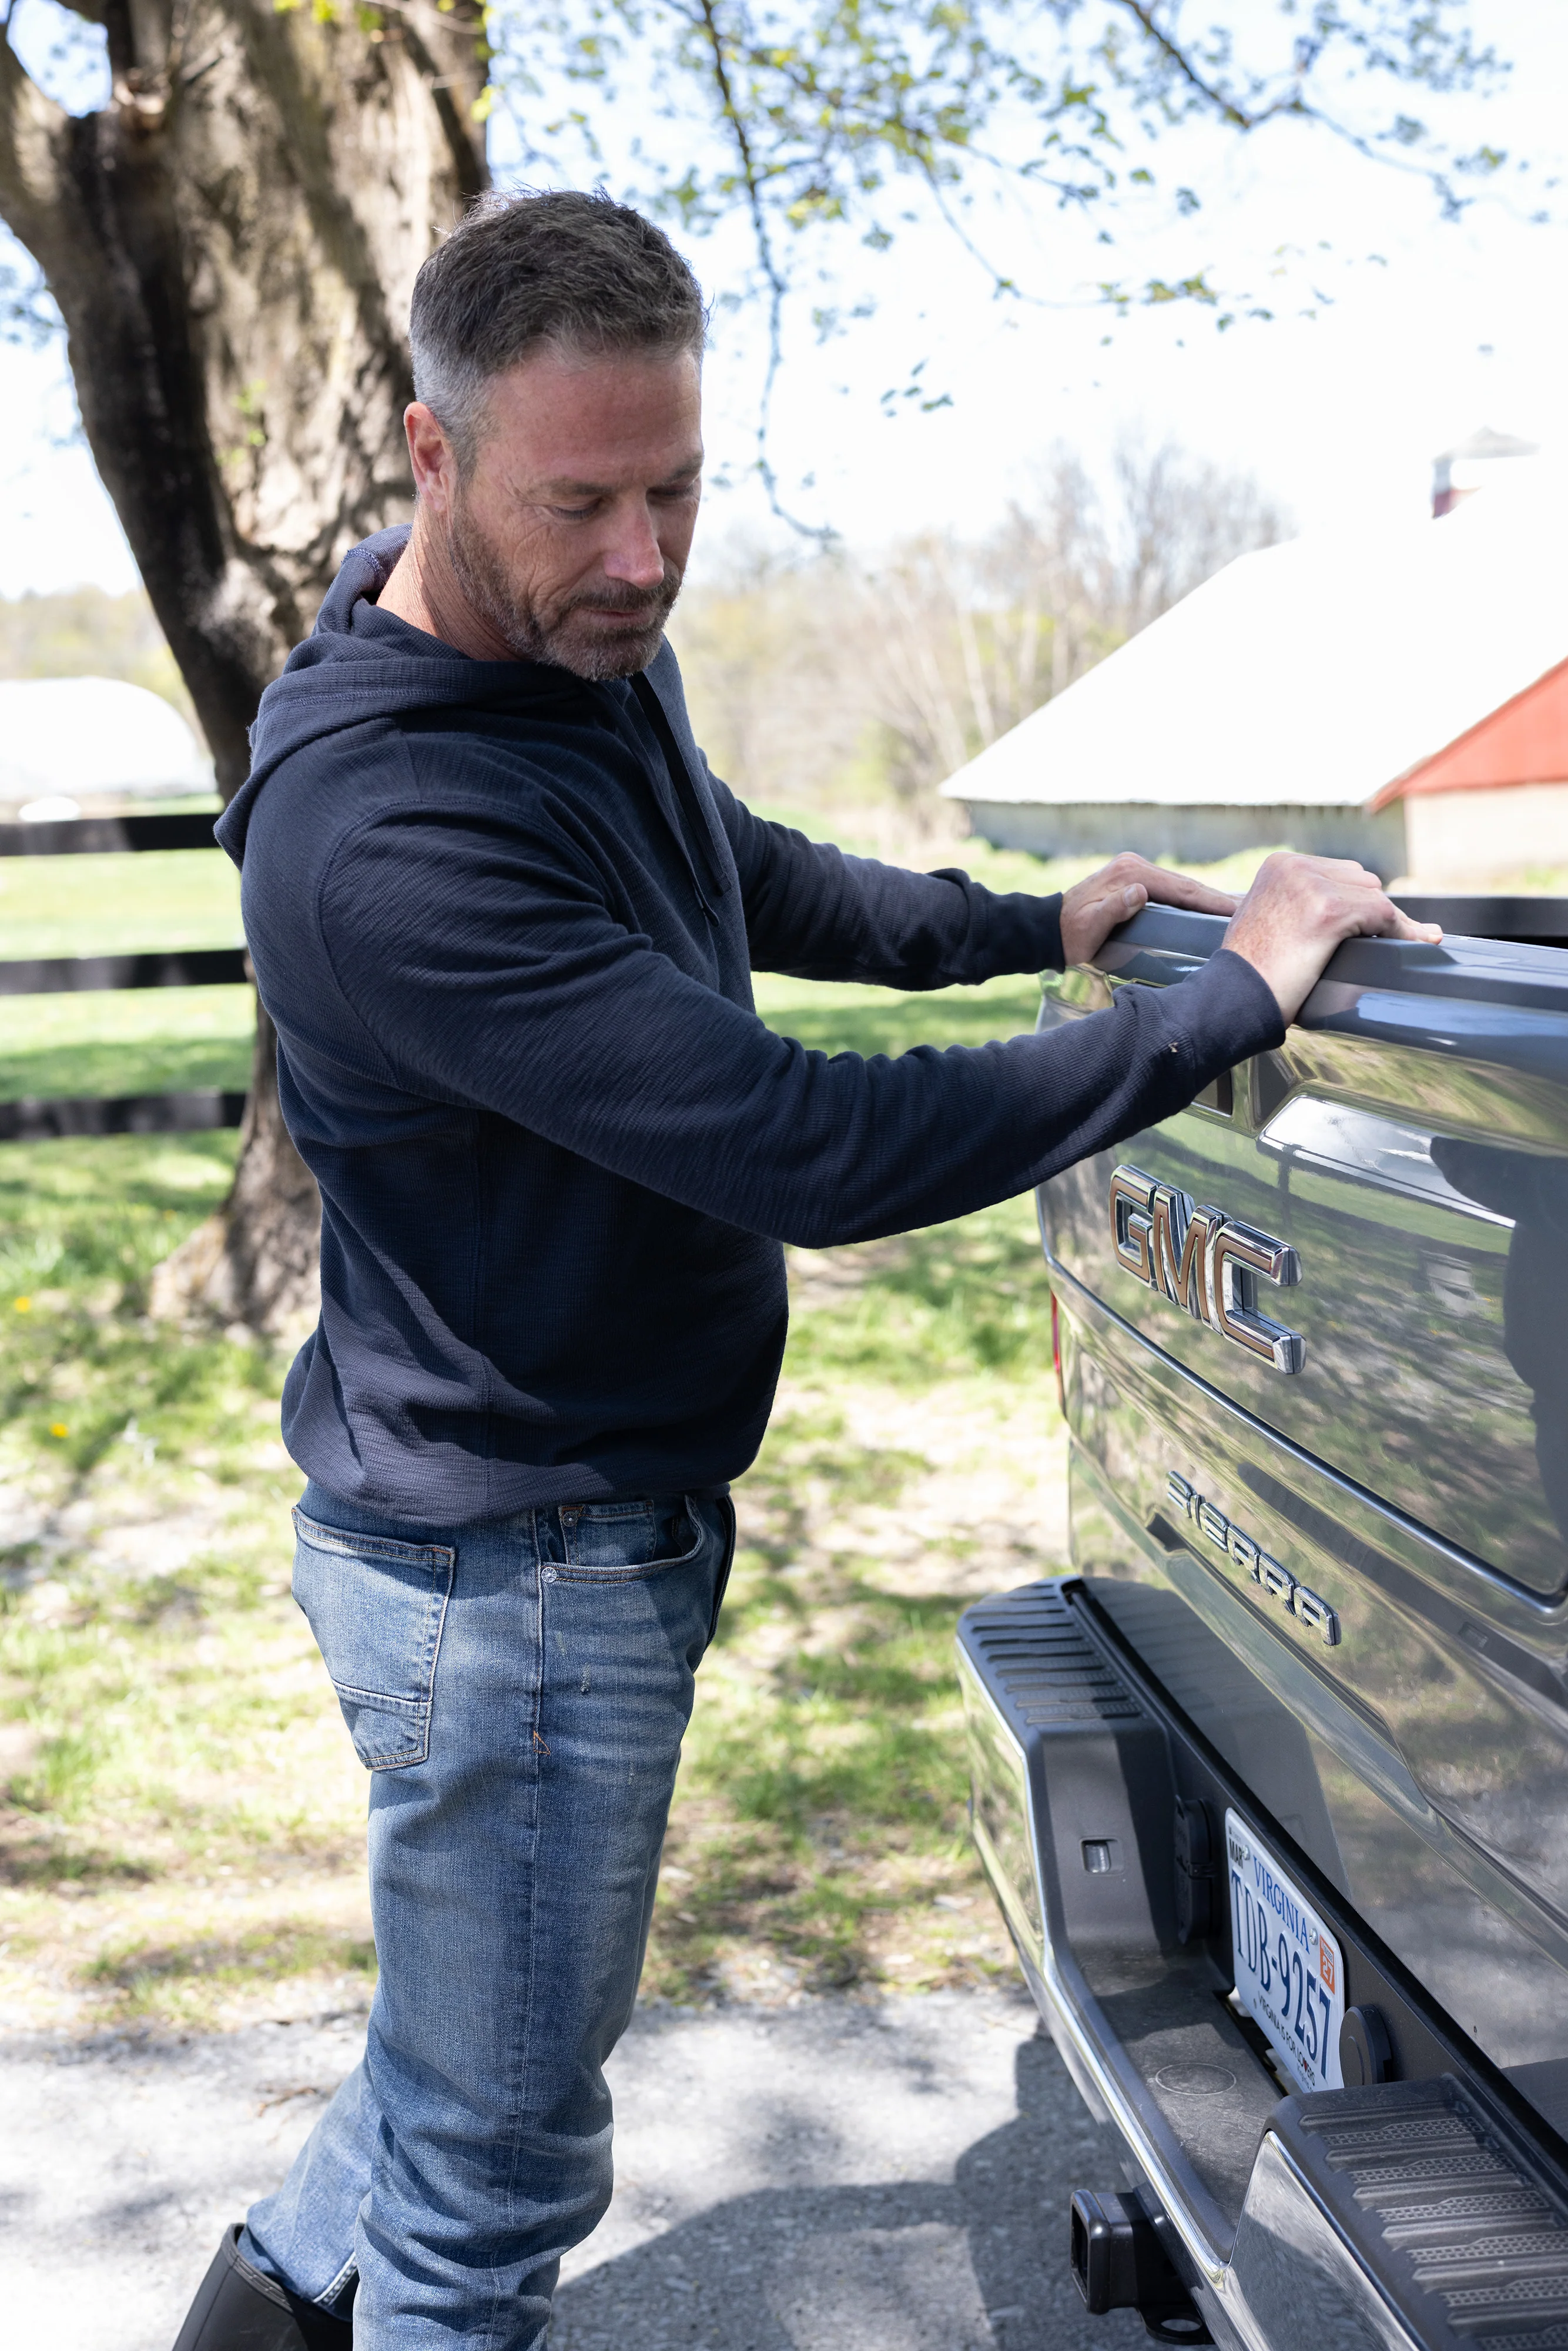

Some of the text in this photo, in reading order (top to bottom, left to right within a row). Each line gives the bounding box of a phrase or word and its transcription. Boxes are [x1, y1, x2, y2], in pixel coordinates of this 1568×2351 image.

[1109, 1164, 1306, 1375] GMC
[1166, 1471, 1341, 1646] SIERRA
[1229, 1837, 1243, 1869] MAR
[1253, 1855, 1310, 1955] VIRGINIA
[1232, 1869, 1331, 2079] TDB-9257
[1322, 1955, 1333, 1985] 27
[1258, 1991, 1281, 2034] VIRGINIA
[1280, 2024, 1286, 2041] IS
[1286, 2030, 1297, 2058] FOR
